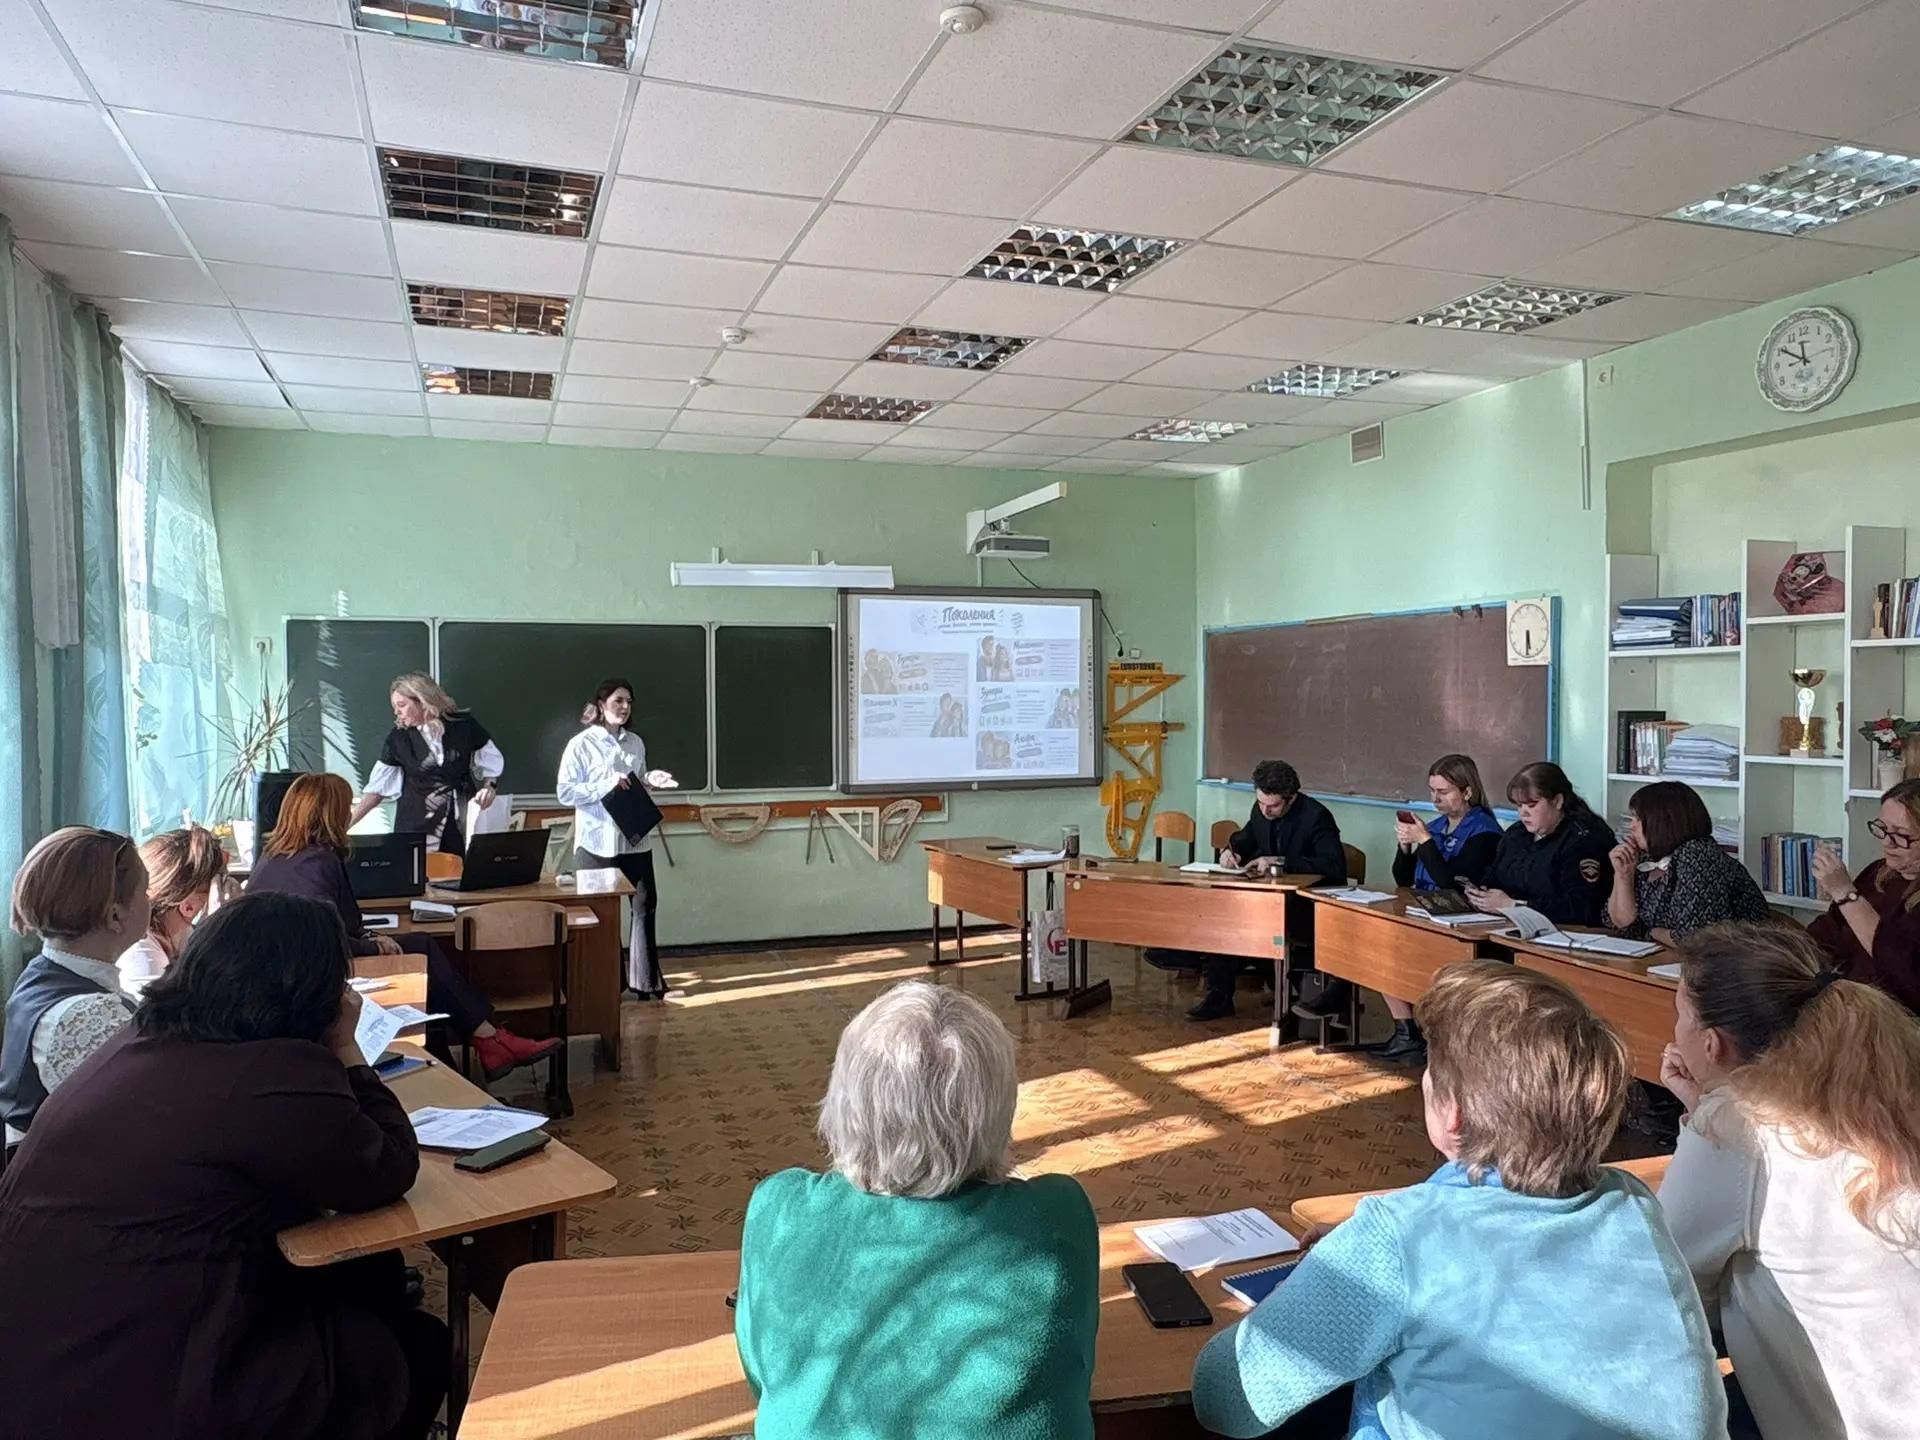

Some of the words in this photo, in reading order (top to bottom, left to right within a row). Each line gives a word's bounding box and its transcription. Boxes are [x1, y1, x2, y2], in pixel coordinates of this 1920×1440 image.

[1799, 325, 1809, 336] 12
[1817, 326, 1821, 335] 1
[1788, 333, 1796, 343] 11
[1825, 333, 1832, 344] 2
[942, 606, 996, 623] Поколения
